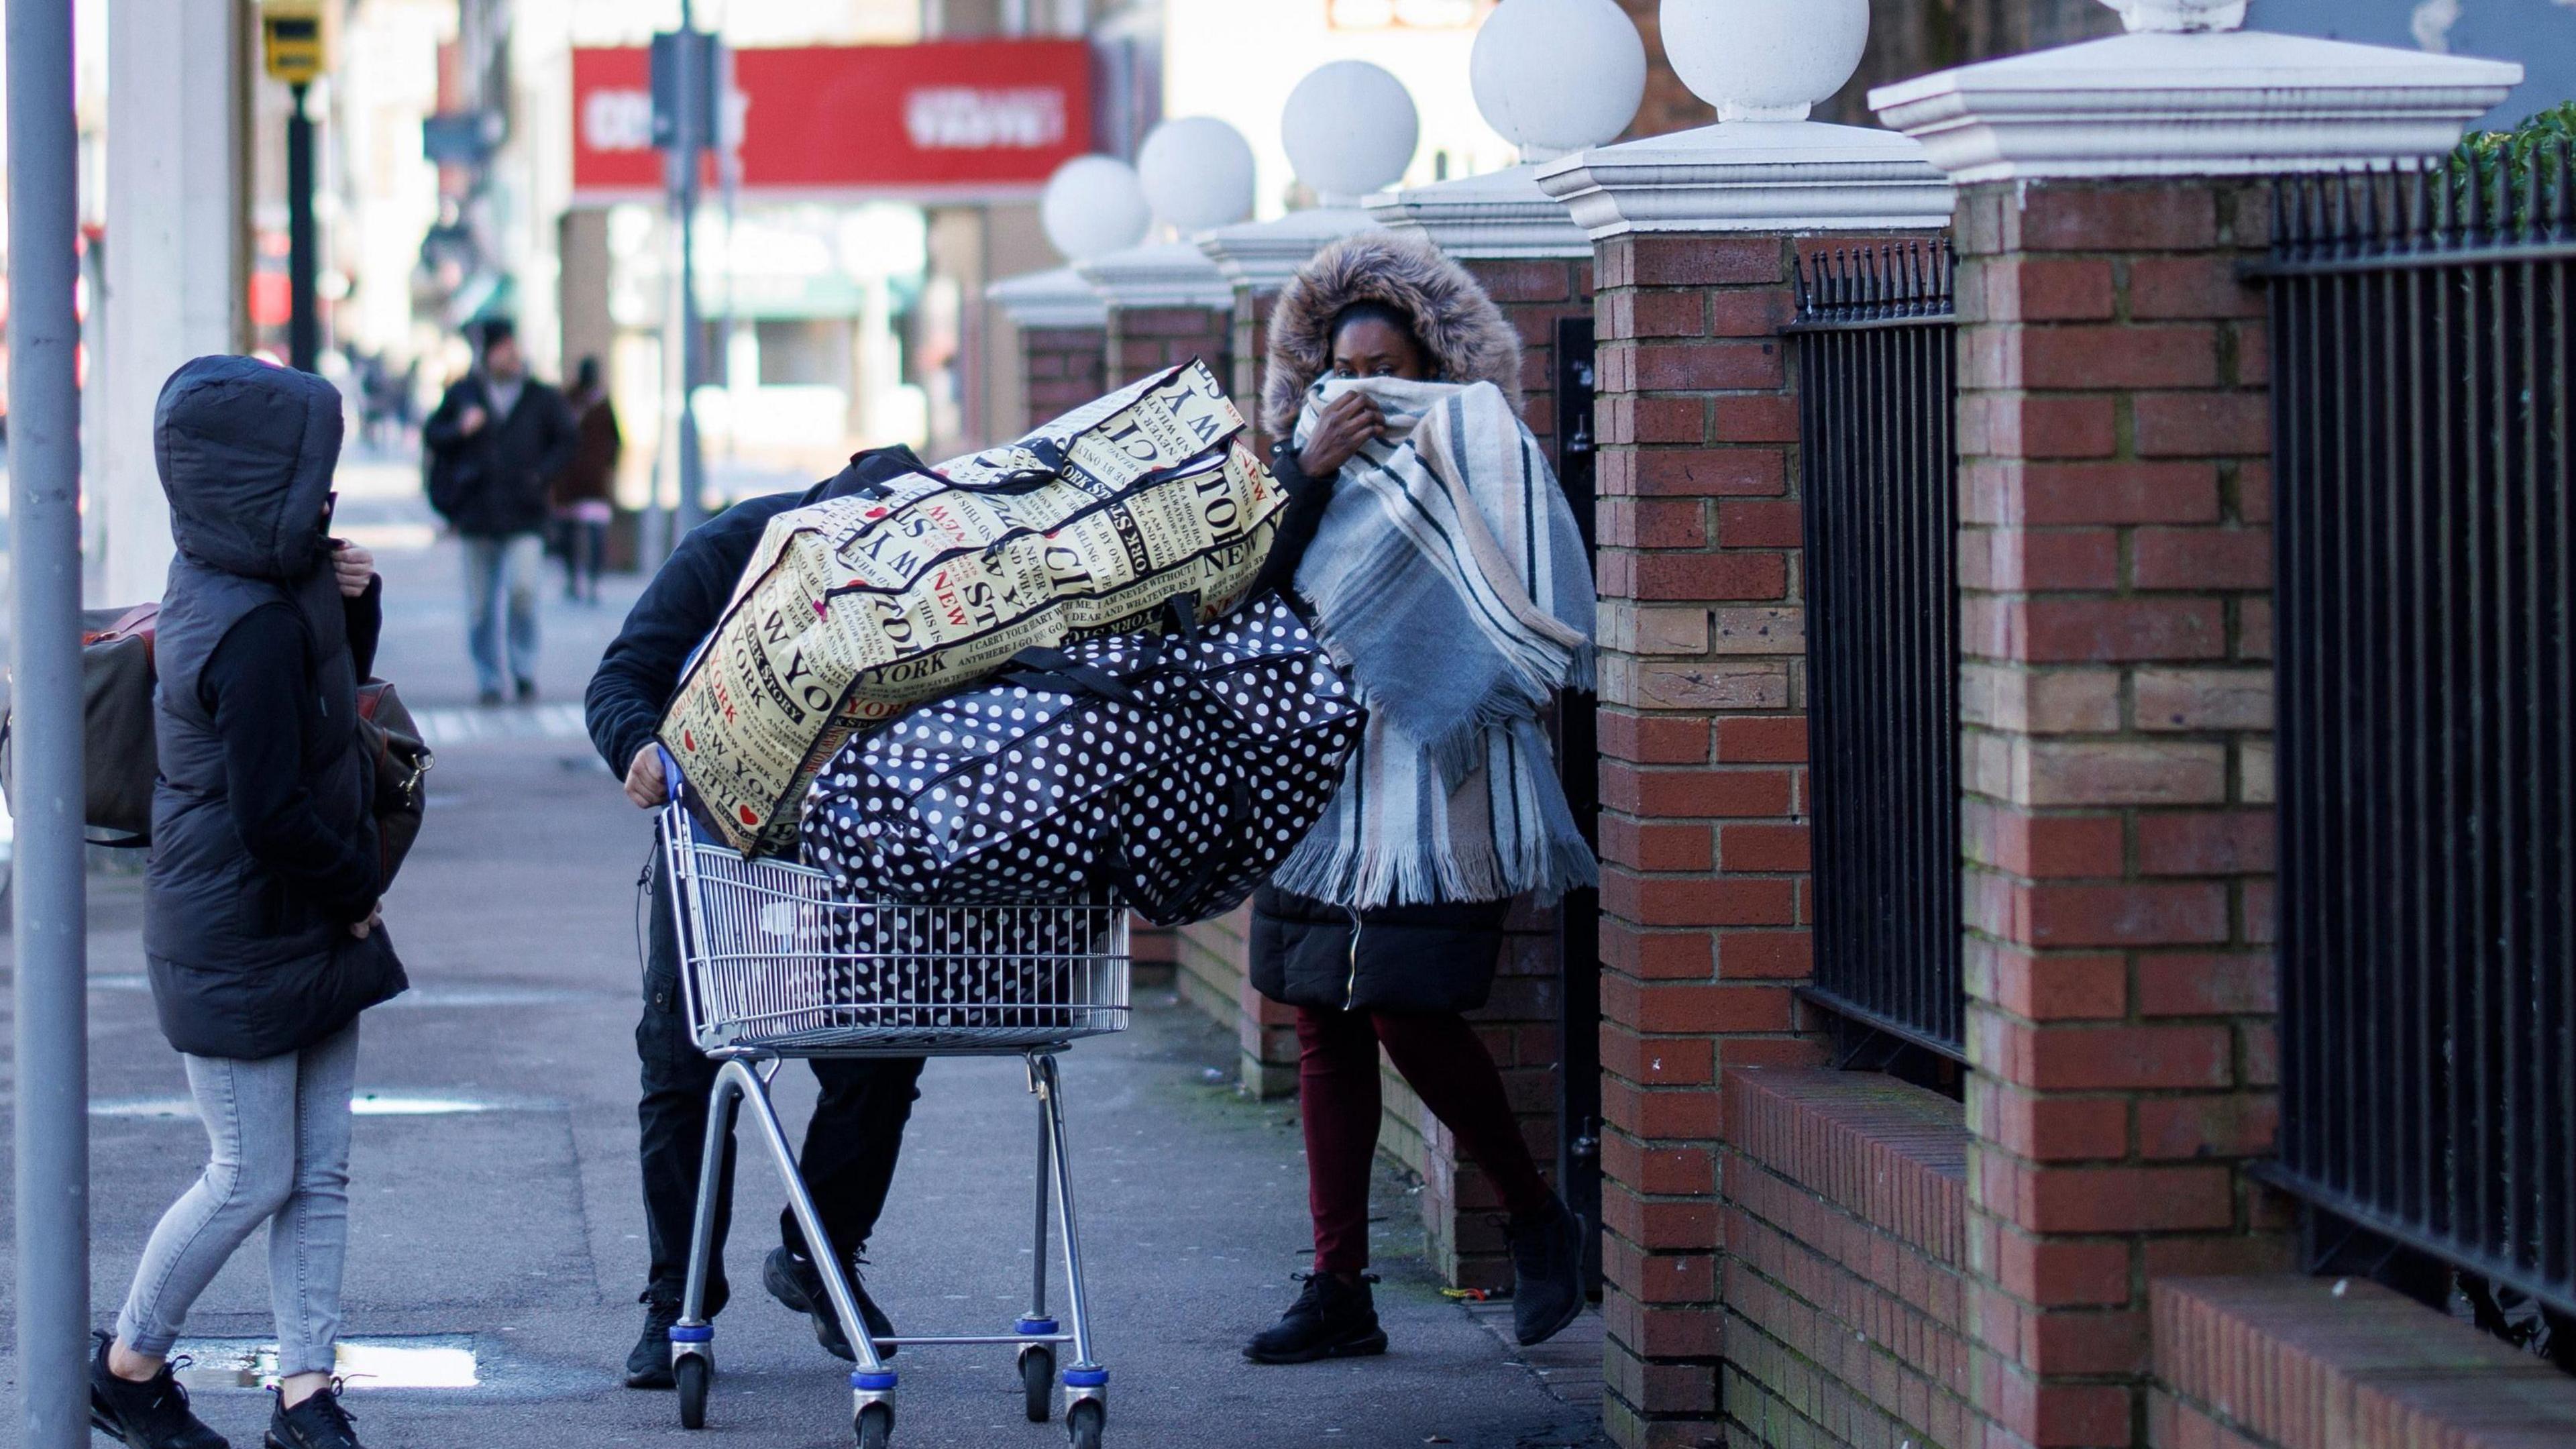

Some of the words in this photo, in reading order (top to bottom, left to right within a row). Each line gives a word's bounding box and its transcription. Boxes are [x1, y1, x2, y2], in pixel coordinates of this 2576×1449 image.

[1161, 385, 1197, 417] Y
[1144, 418, 1177, 455] NEVER
[1077, 445, 1101, 464] ONLY
[1101, 462, 1114, 475] BY
[1061, 459, 1092, 488] ORK
[1236, 451, 1267, 502] NEW
[960, 500, 981, 525] THIS
[1168, 489, 1185, 523] ALWAYS
[1239, 477, 1250, 505] THIS
[1246, 508, 1254, 521] IS
[1142, 521, 1157, 541] AND
[1163, 504, 1179, 535] KNOWS
[1184, 502, 1197, 528] MOON
[1192, 529, 1203, 545] HAS
[859, 529, 894, 561] Y
[1099, 531, 1114, 545] BY
[1109, 547, 1128, 578] ONLY
[887, 550, 919, 579] W
[1024, 545, 1047, 590] NEVER
[927, 569, 969, 626] NEW
[975, 631, 1007, 651] CARRY
[1006, 624, 1030, 640] YOUR
[1104, 598, 1117, 608] AM
[1120, 585, 1148, 600] NEVER
[1149, 568, 1192, 588] WITHOUT
[1000, 584, 1026, 608] Y
[1073, 612, 1101, 622] DEAR
[1104, 604, 1124, 619] AND
[1126, 585, 1175, 609] WHATEVER
[1179, 579, 1188, 590] IS
[918, 597, 936, 627] THIS
[930, 631, 943, 643] IS
[732, 625, 767, 710] YORK
[873, 651, 948, 685] YORK
[957, 643, 1012, 667] ANYWHERE
[1019, 636, 1032, 648] GO
[761, 664, 802, 719] STORY
[696, 688, 729, 756] NEW
[739, 747, 772, 780] YORK
